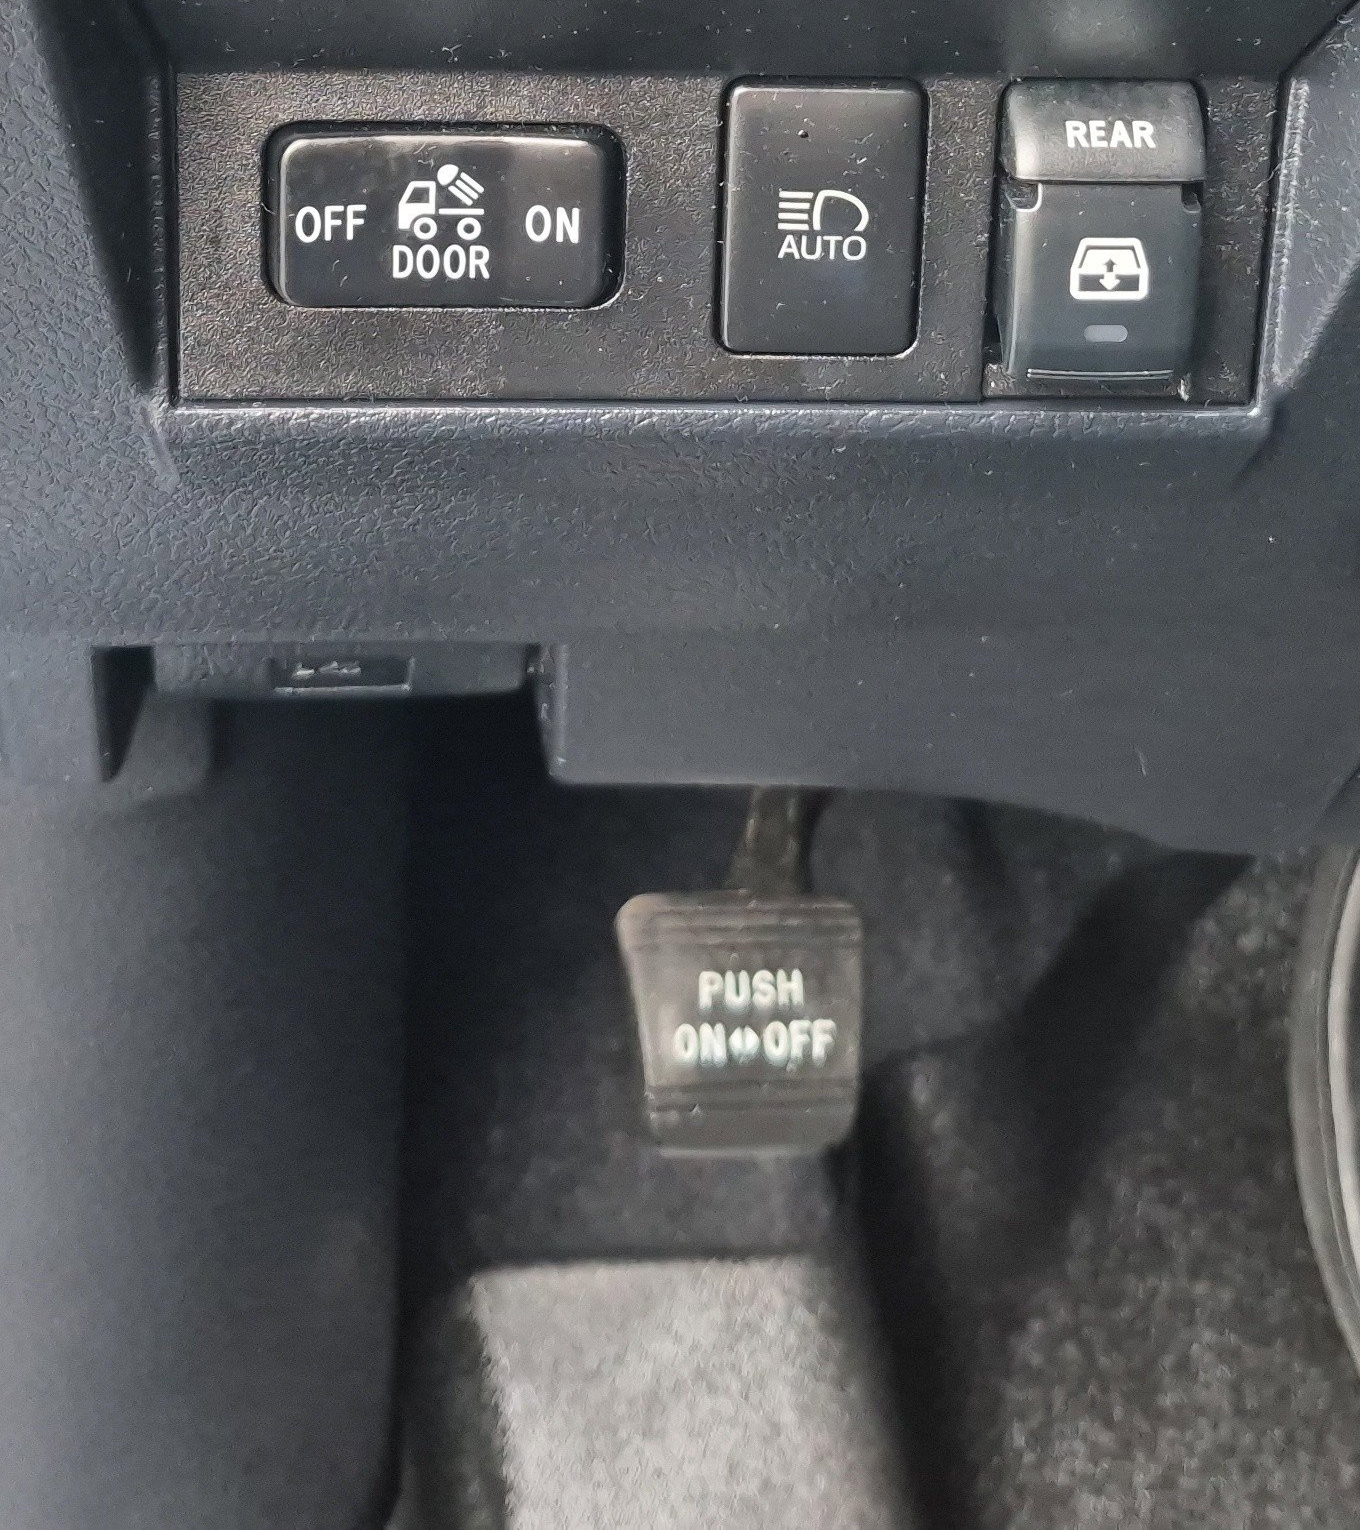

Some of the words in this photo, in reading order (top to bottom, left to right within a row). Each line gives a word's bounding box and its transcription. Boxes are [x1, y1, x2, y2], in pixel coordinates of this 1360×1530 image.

[1065, 120, 1156, 149] REAR
[295, 204, 368, 243] OFF
[525, 205, 581, 244] ON
[392, 244, 491, 280] DOOR
[777, 235, 868, 261] AUTO
[697, 969, 805, 1011] PUSH
[673, 1022, 728, 1069] ON
[762, 1018, 837, 1069] OFF
